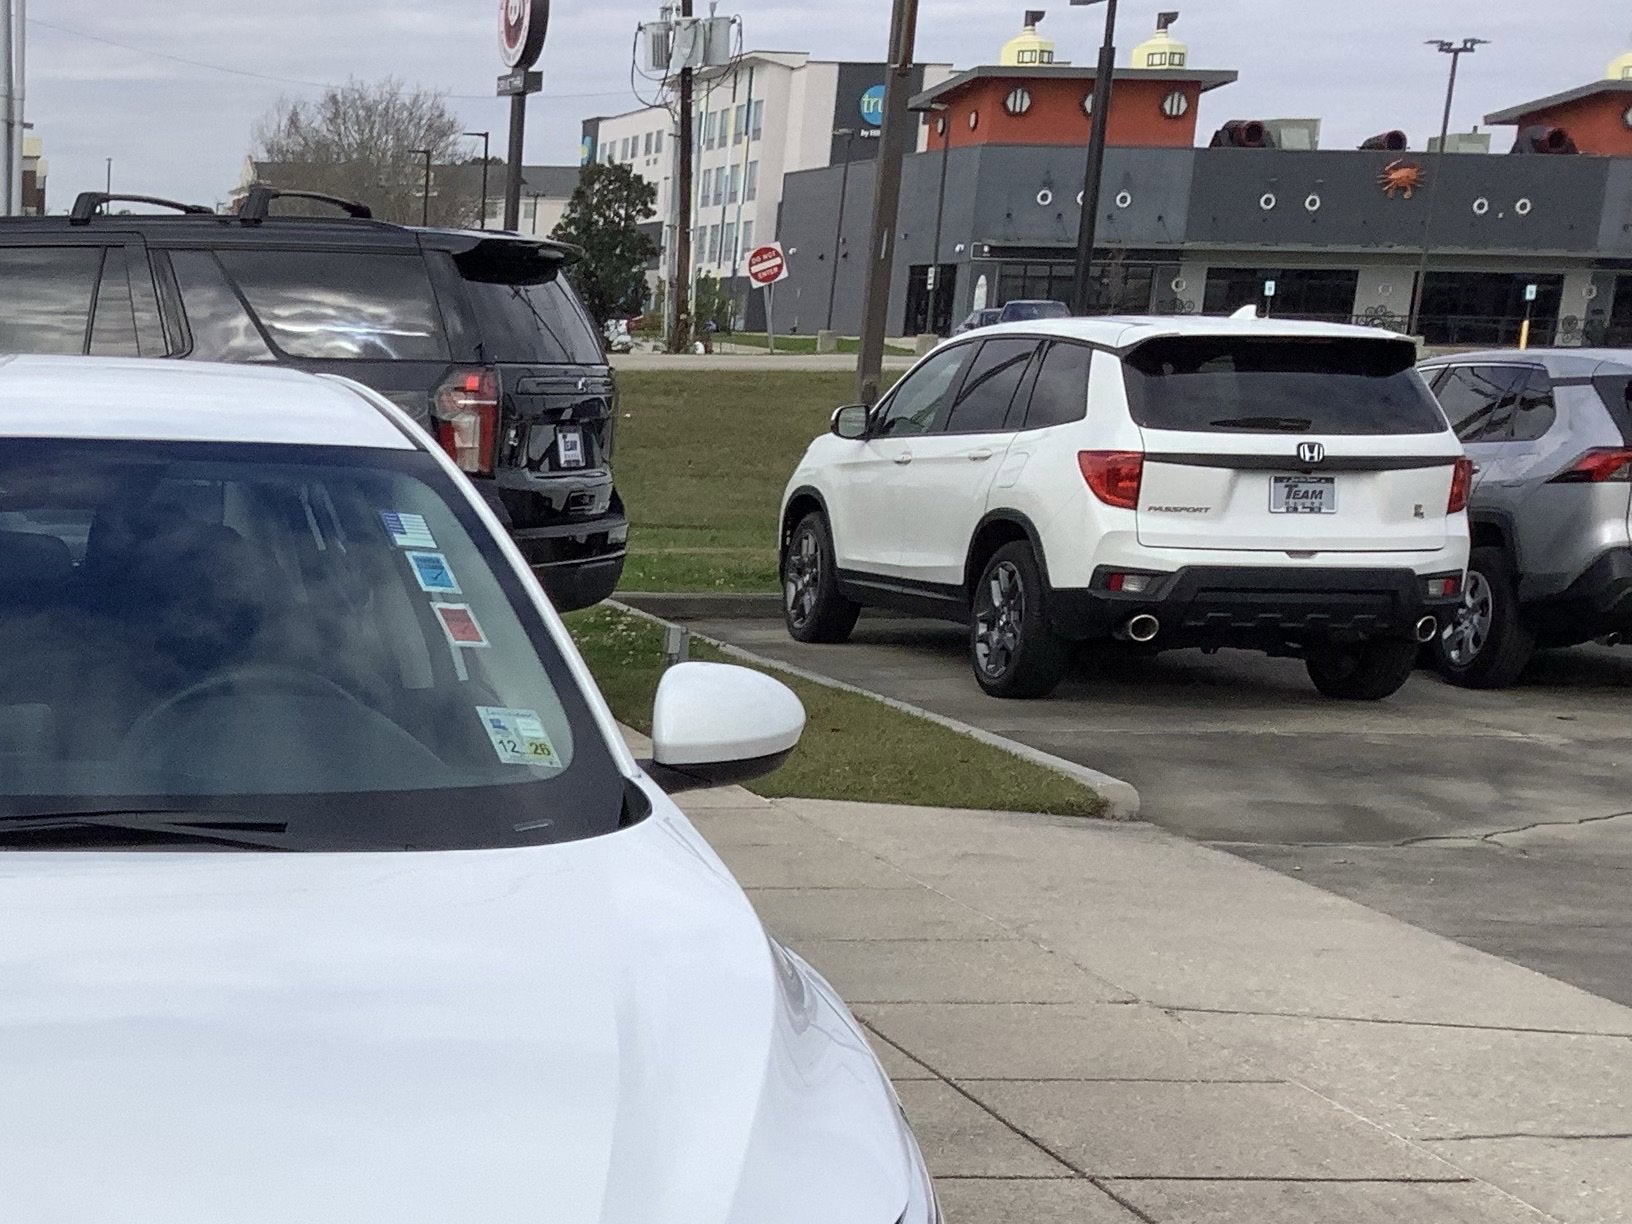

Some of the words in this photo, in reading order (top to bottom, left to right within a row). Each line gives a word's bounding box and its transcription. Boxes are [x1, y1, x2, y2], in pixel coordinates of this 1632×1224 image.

[751, 256, 762, 264] DO
[763, 250, 776, 260] NOT
[758, 266, 778, 279] ENTER
[1284, 484, 1324, 500] TEAM
[498, 740, 519, 753] 12
[529, 742, 551, 756] 26
